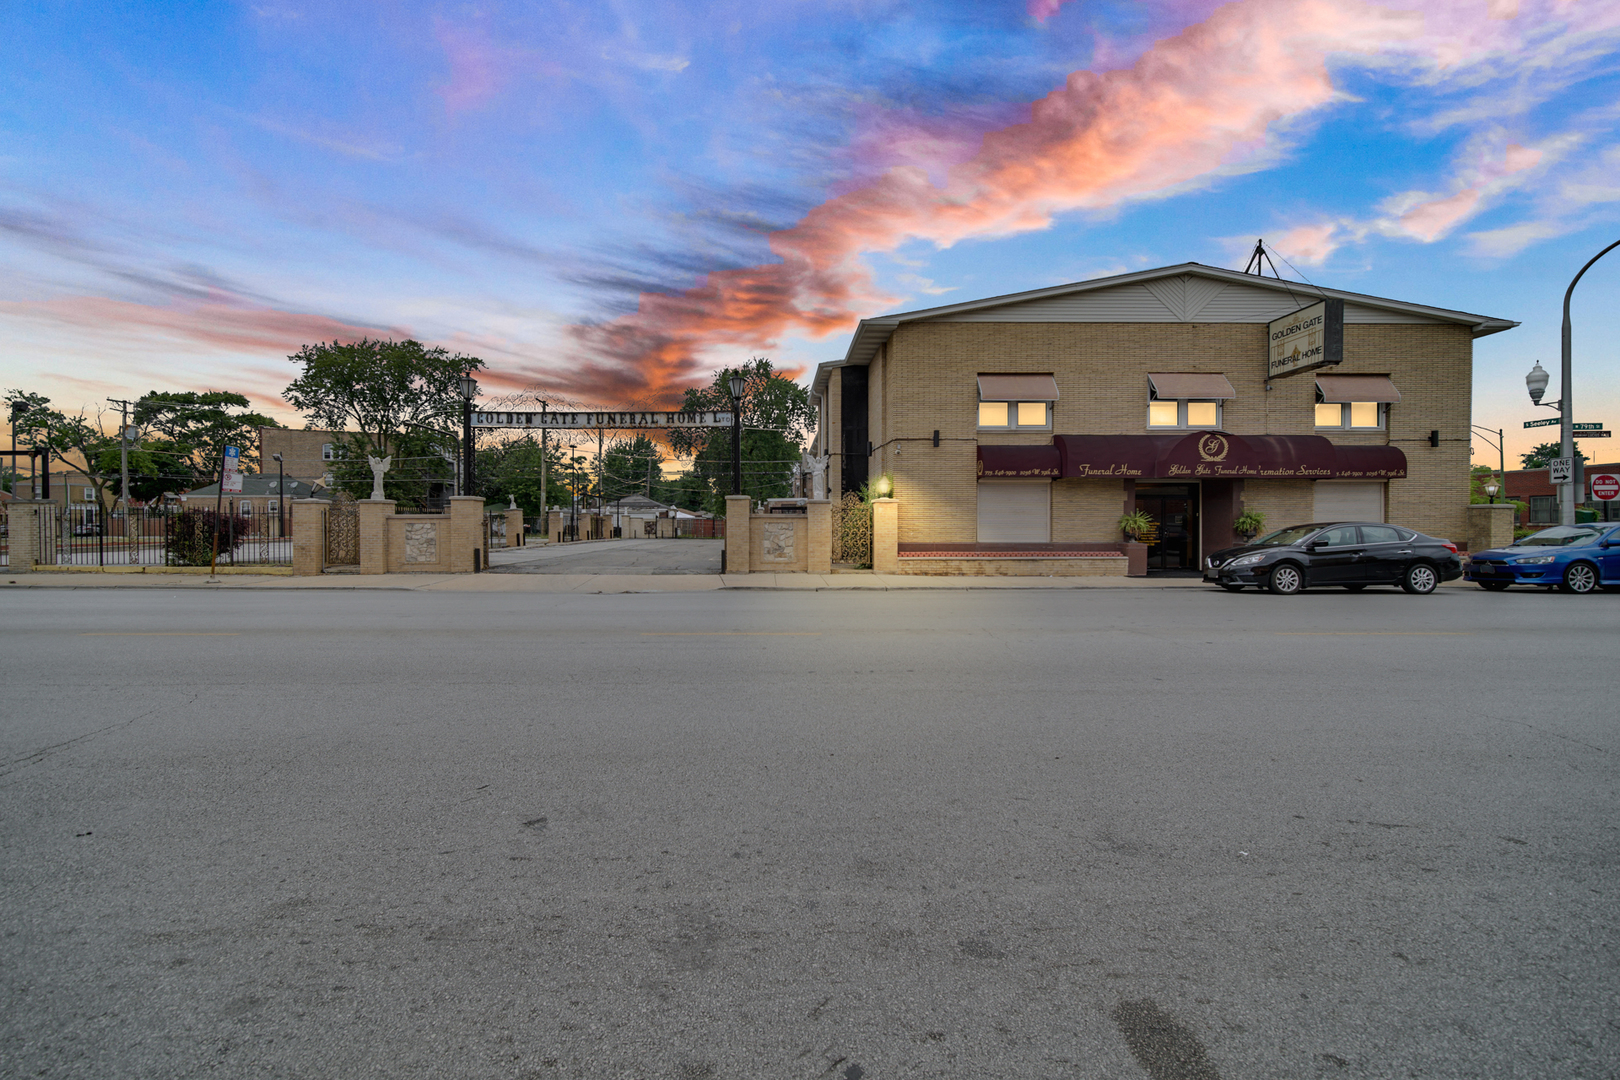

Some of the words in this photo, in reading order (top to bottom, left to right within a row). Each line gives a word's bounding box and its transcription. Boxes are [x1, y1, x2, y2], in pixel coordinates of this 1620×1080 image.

[1272, 324, 1302, 341] GOLDEN
[1302, 315, 1322, 330] GATE
[1271, 353, 1300, 369] FUNERAL
[1302, 346, 1322, 359] HOME
[476, 413, 532, 424] GOLDEN
[540, 413, 578, 424] GATE
[586, 412, 658, 424] FUNERAL
[666, 412, 706, 424] HOME
[1079, 464, 1114, 477] Funeral
[1114, 463, 1142, 476] Home
[1168, 464, 1191, 476] Golden
[1195, 464, 1211, 476] Gate
[1214, 465, 1238, 476] Funeral
[1239, 465, 1257, 475] Home
[1296, 465, 1331, 476] Services
